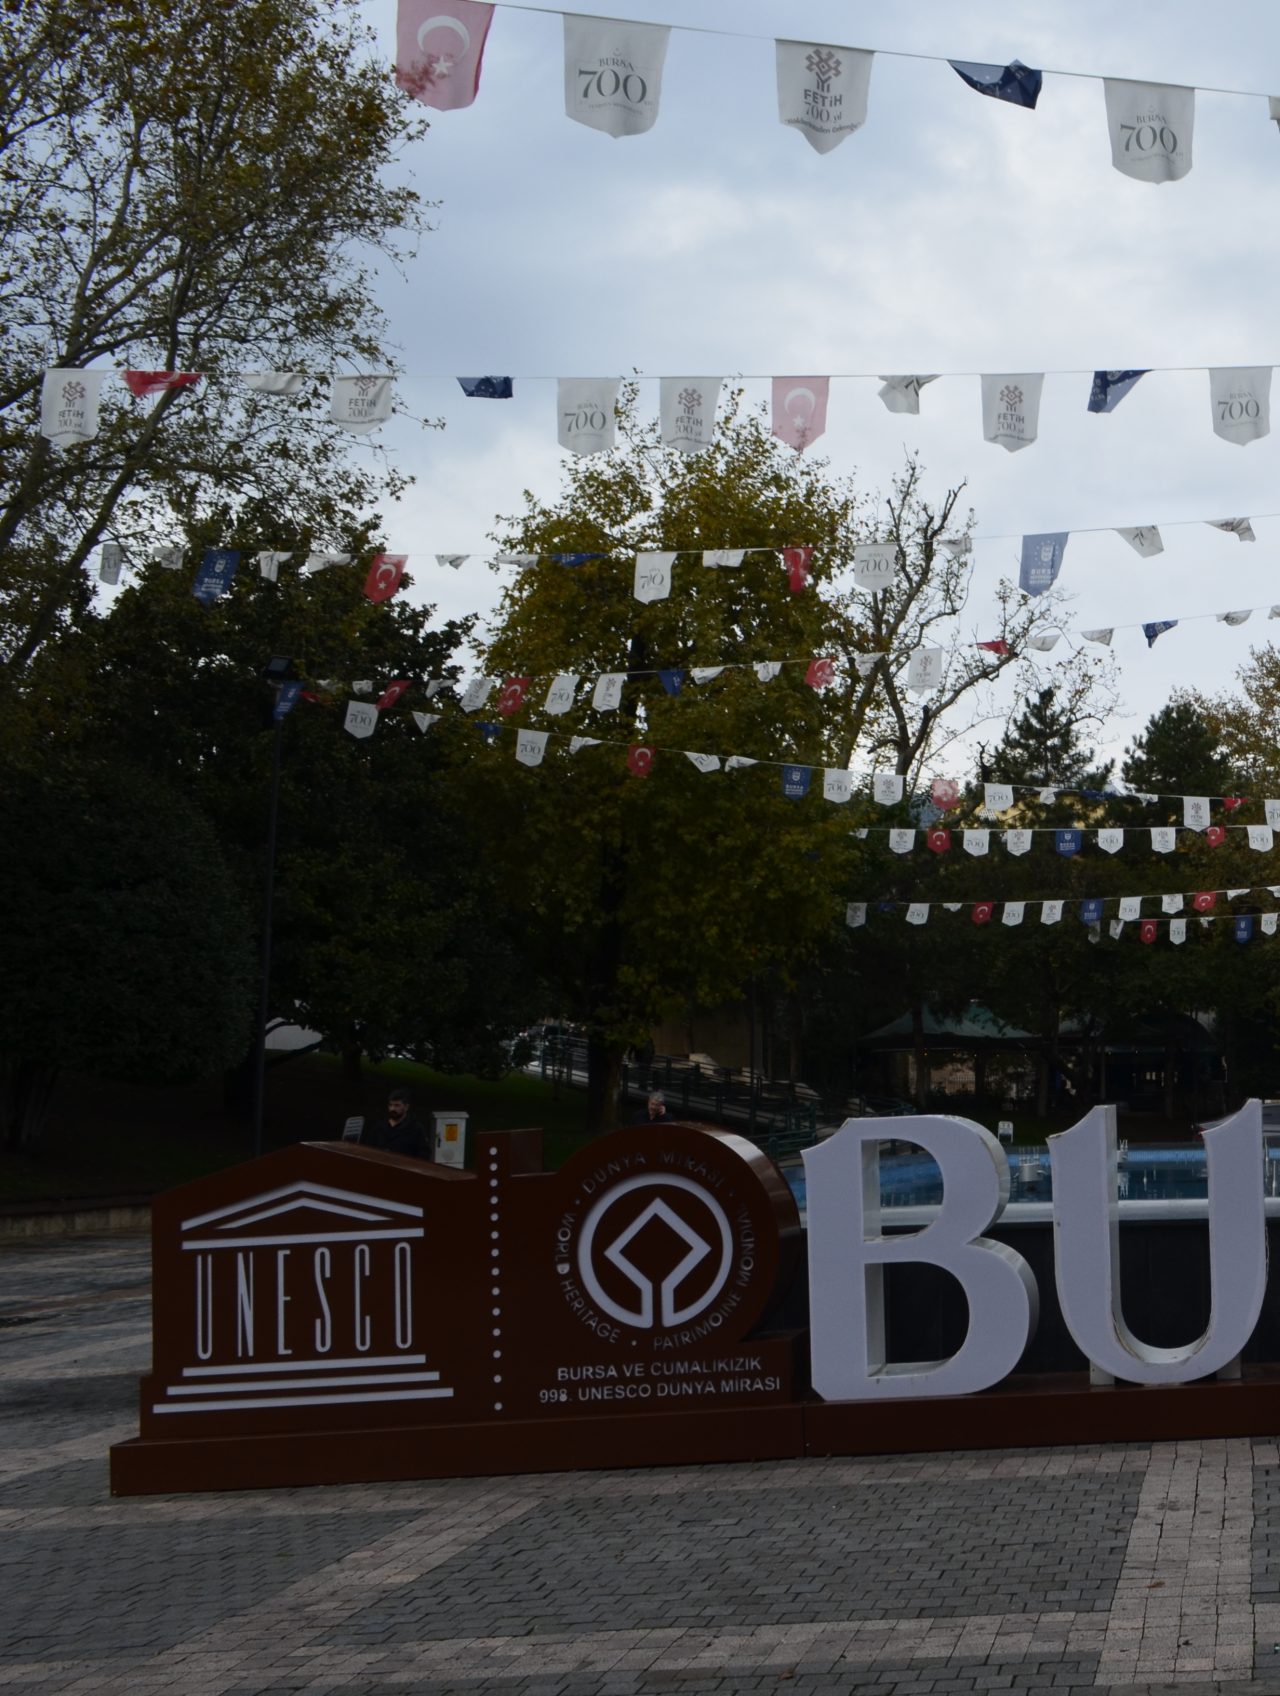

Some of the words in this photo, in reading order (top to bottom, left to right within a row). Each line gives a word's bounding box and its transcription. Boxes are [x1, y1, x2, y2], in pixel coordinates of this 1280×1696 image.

[599, 57, 635, 72] BURSA
[578, 67, 648, 104] 700
[1119, 123, 1178, 155] 700
[563, 411, 607, 433] 700
[1217, 399, 1261, 421] 700
[859, 559, 890, 575] 700
[349, 712, 373, 724] 700
[519, 743, 541, 754] 700
[555, 1211, 577, 1276] WORLD
[653, 1289, 743, 1351] PATRIMOINE
[735, 1202, 756, 1288] MONDIAL
[196, 1241, 413, 1361] UNESCO
[559, 1278, 622, 1345] HERITAGE
[556, 1364, 619, 1382] BURSA
[622, 1362, 646, 1378] VE
[650, 1355, 763, 1377] CUMALIKIZIK
[578, 1383, 652, 1401] UNESCO
[720, 1374, 781, 1394] MİRASI
